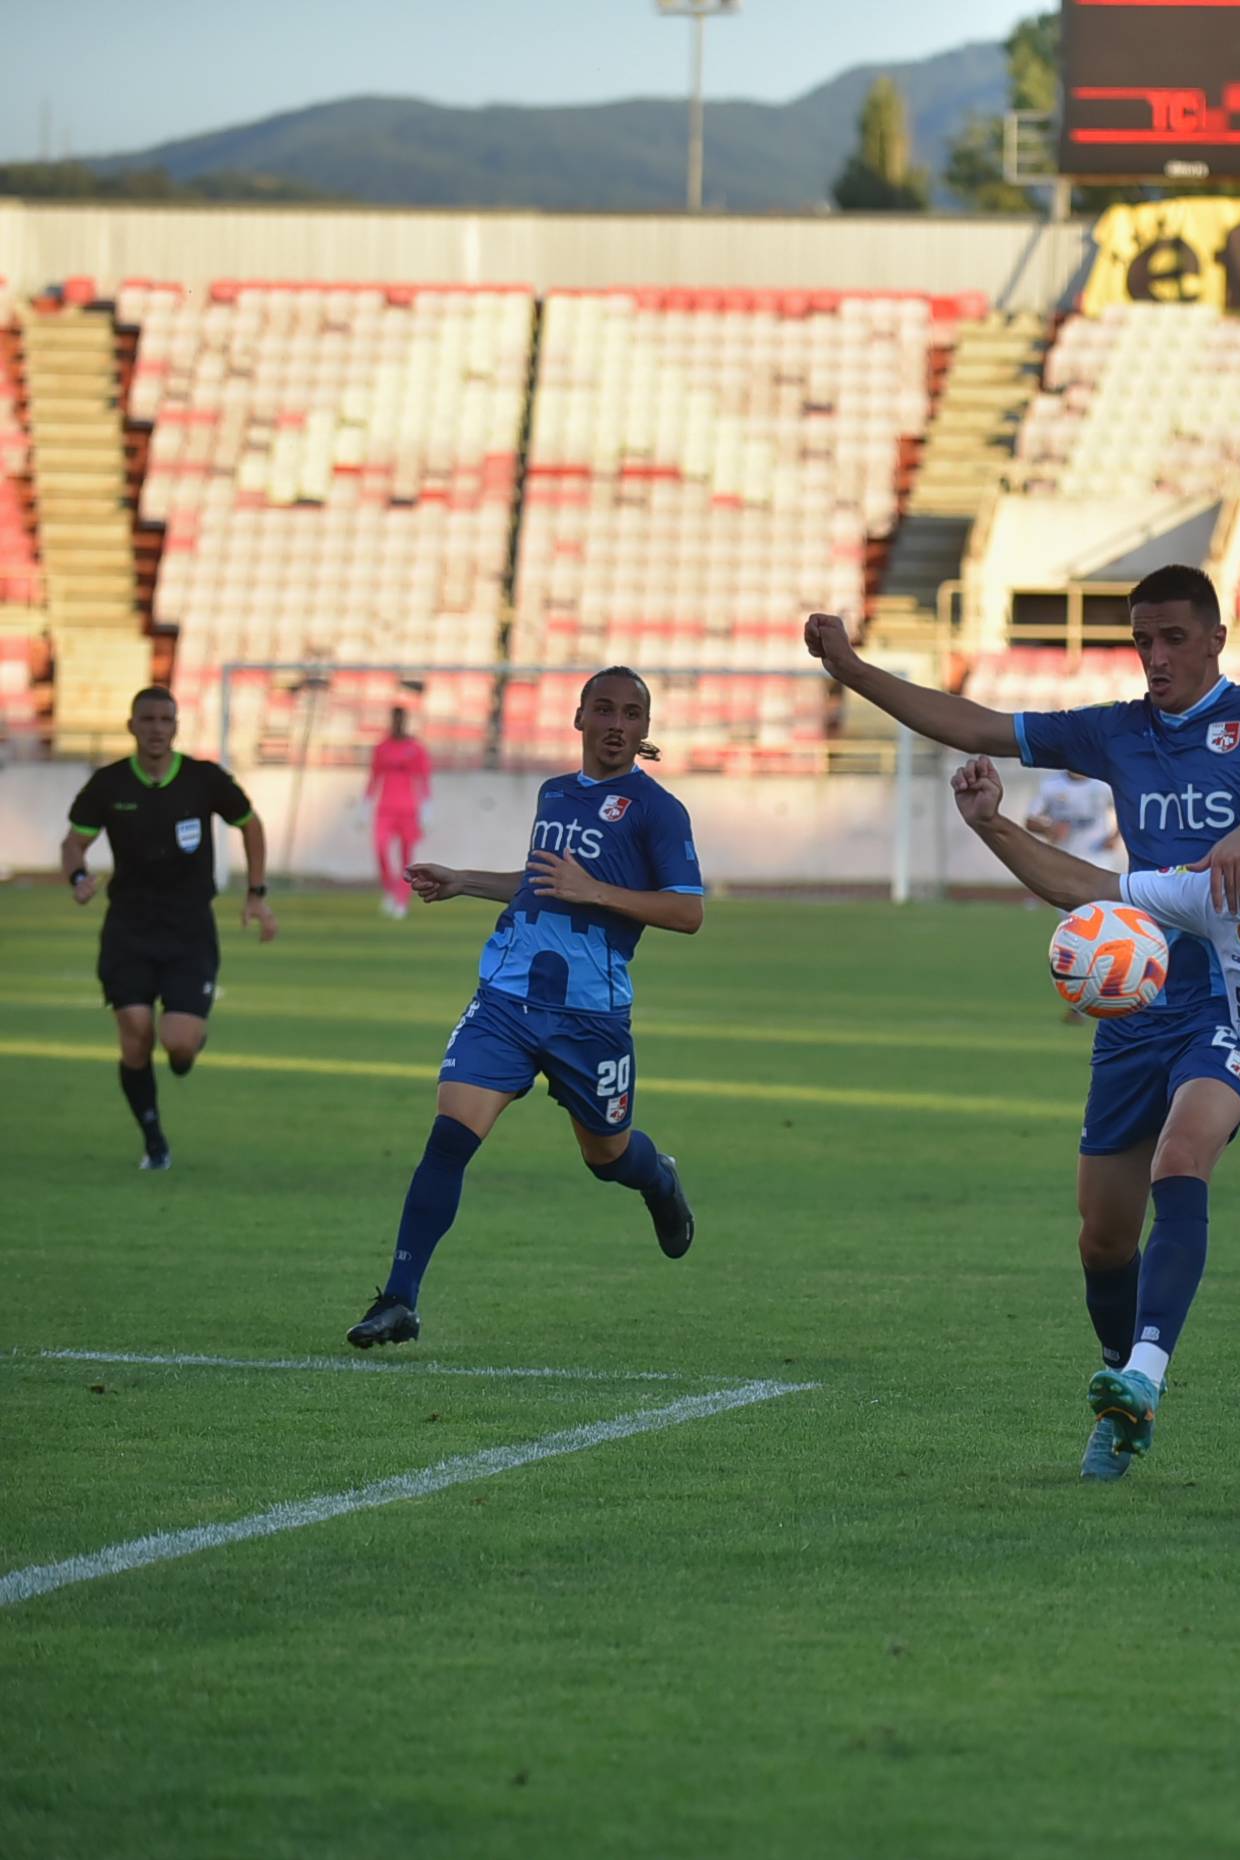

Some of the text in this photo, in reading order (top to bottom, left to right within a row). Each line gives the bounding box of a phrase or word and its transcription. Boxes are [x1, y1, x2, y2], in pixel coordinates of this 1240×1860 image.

[1140, 783, 1235, 830] mts
[531, 818, 604, 859] mts
[597, 1054, 631, 1096] 20
